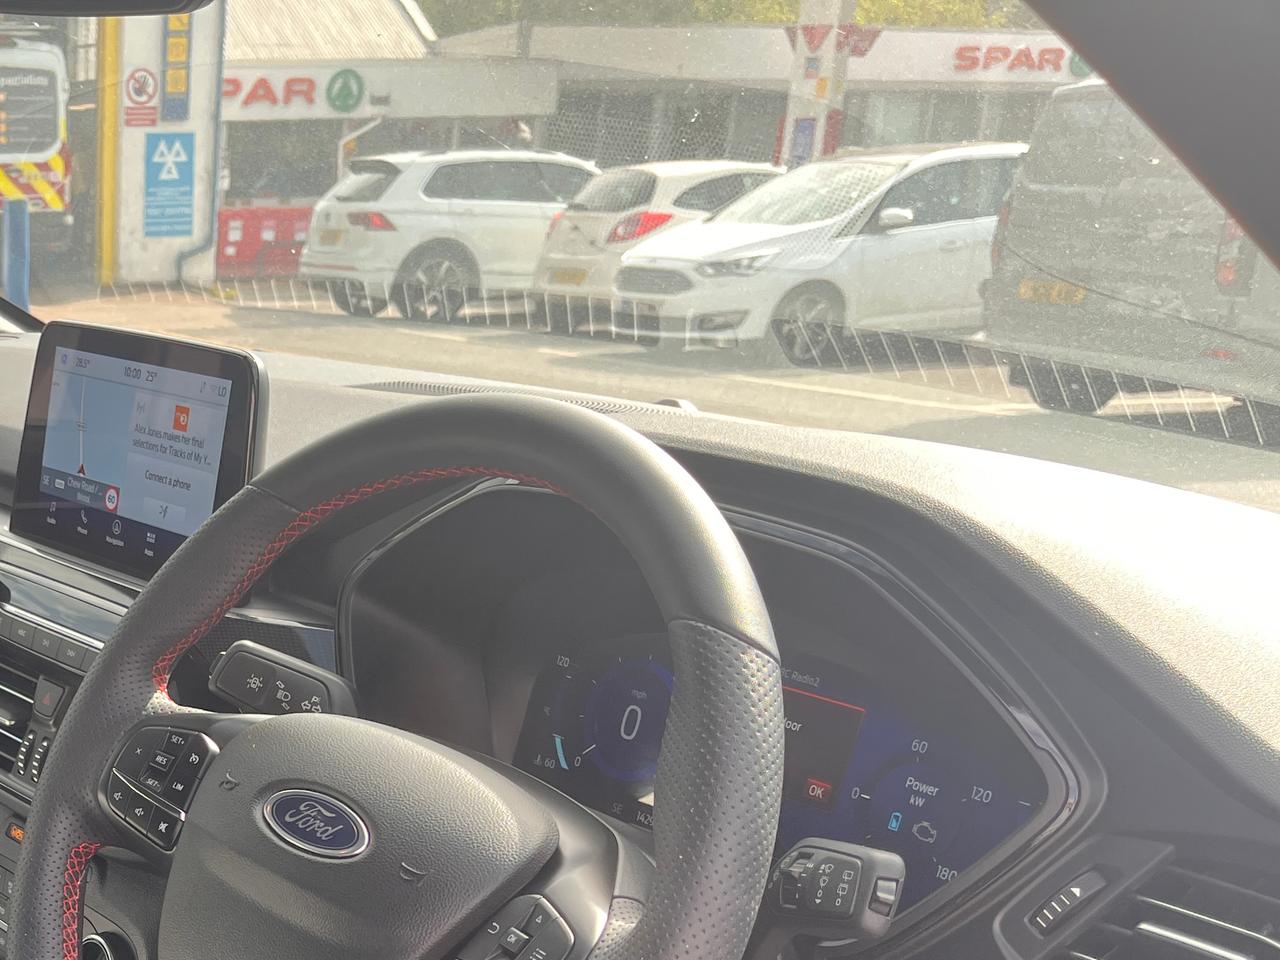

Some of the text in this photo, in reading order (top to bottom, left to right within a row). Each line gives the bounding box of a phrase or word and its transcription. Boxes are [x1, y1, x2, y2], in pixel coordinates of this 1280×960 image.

[954, 46, 1066, 72] SPAR
[145, 469, 168, 486] Connect
[172, 477, 191, 491] phone
[556, 654, 570, 668] 120
[620, 704, 642, 741] 0
[784, 716, 803, 732] oor
[910, 738, 929, 754] 60
[155, 754, 168, 765] RES
[543, 757, 557, 769] 60
[808, 783, 826, 800] OK
[905, 775, 941, 798] Power
[971, 785, 993, 804] 120
[908, 795, 926, 808] kW
[283, 801, 344, 842] Ford
[935, 863, 958, 882] 180
